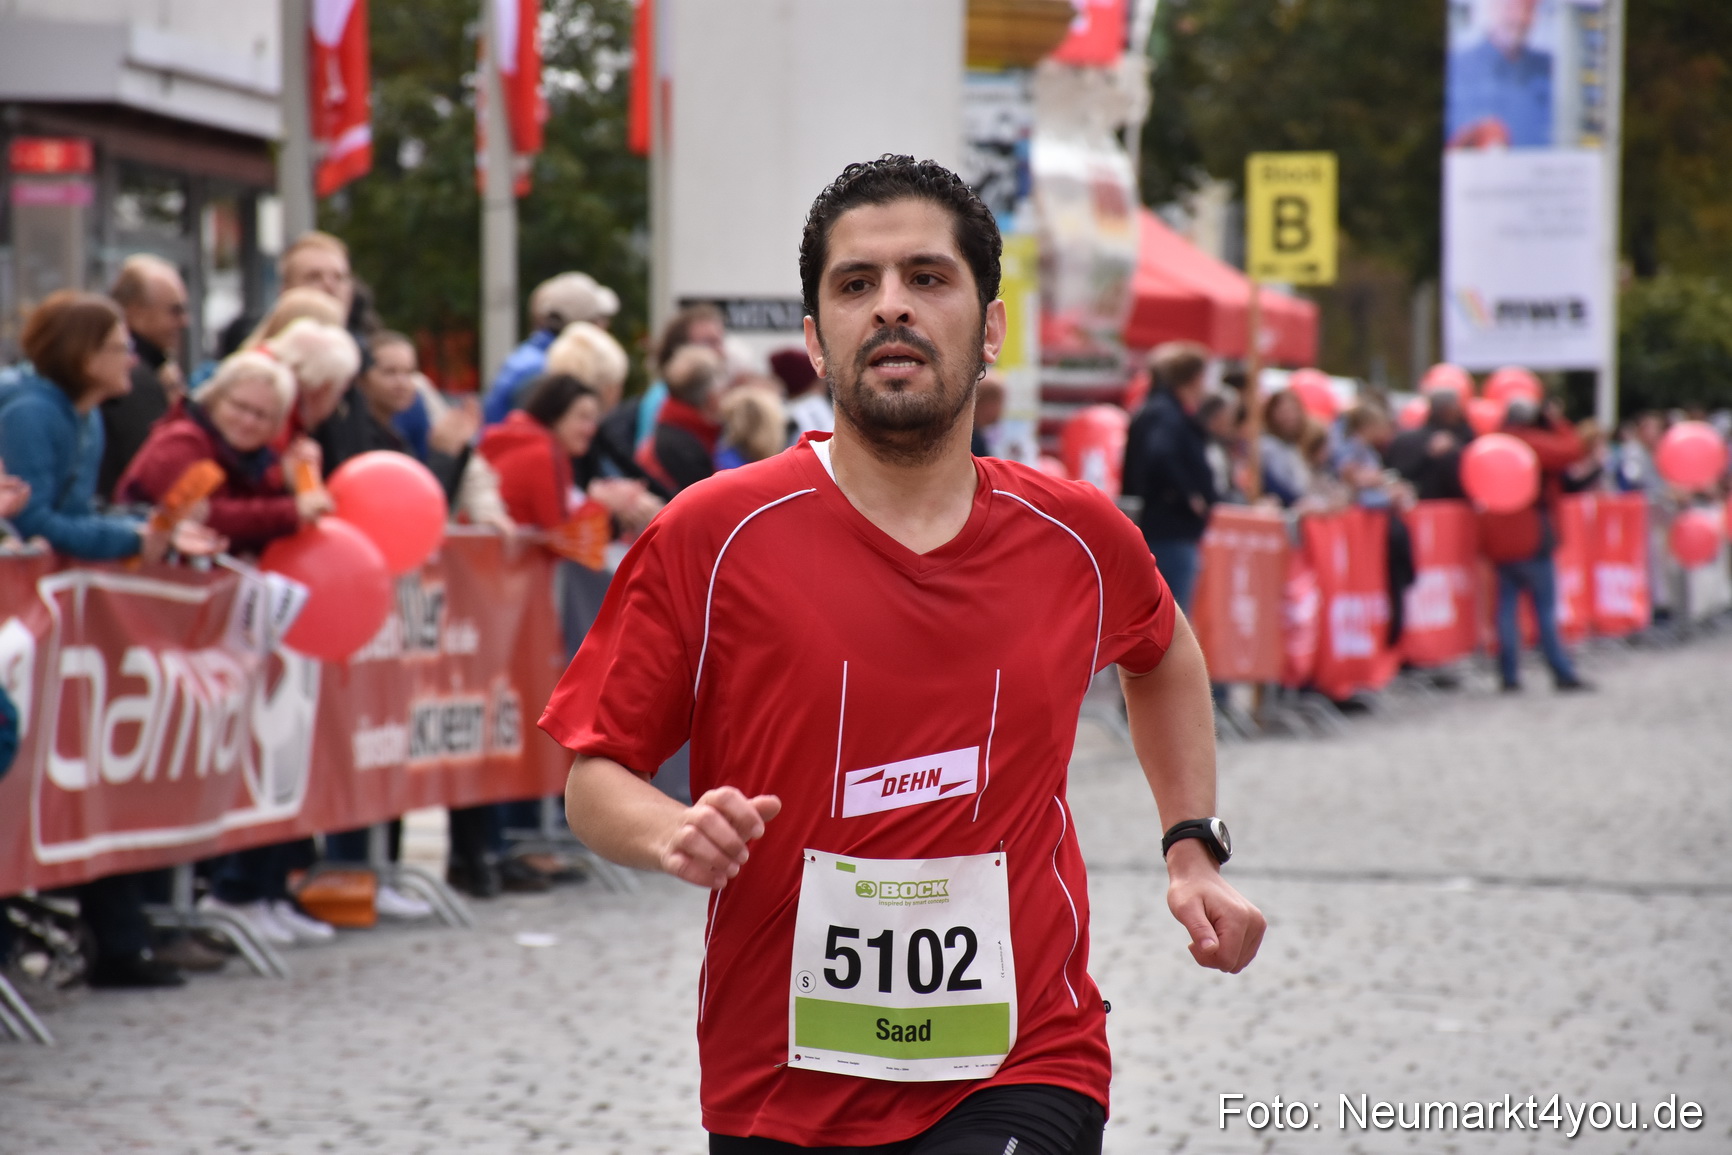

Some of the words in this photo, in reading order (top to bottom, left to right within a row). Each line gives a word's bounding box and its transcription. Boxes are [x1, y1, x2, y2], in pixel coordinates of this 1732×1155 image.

[1271, 195, 1312, 253] B
[881, 767, 942, 798] DEHN
[880, 879, 949, 899] BOCK
[905, 899, 912, 907] by
[824, 925, 982, 994] 5102
[802, 976, 810, 988] S
[876, 1018, 932, 1042] Saad
